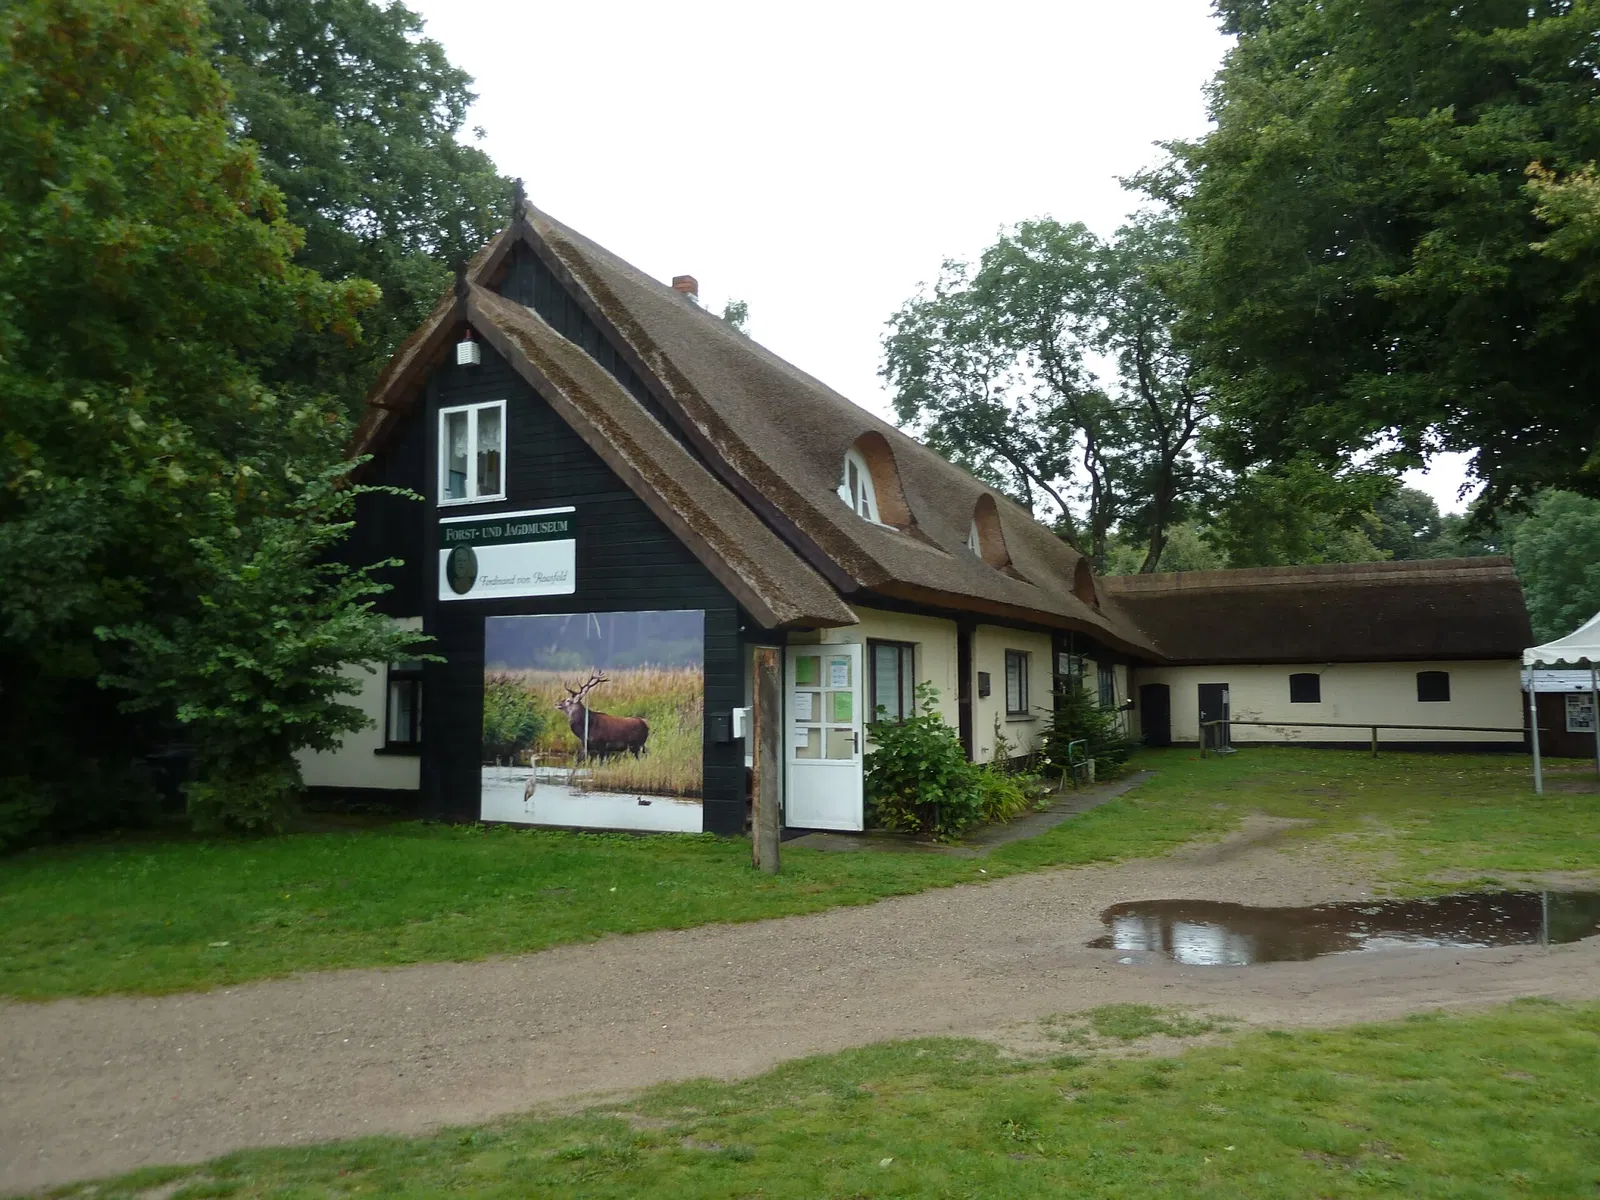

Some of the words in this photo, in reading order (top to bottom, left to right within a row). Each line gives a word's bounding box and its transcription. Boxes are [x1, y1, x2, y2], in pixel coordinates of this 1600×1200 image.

[446, 528, 480, 542] FORST-
[482, 526, 502, 539] UND
[504, 520, 569, 537] JAGDMUSEUM
